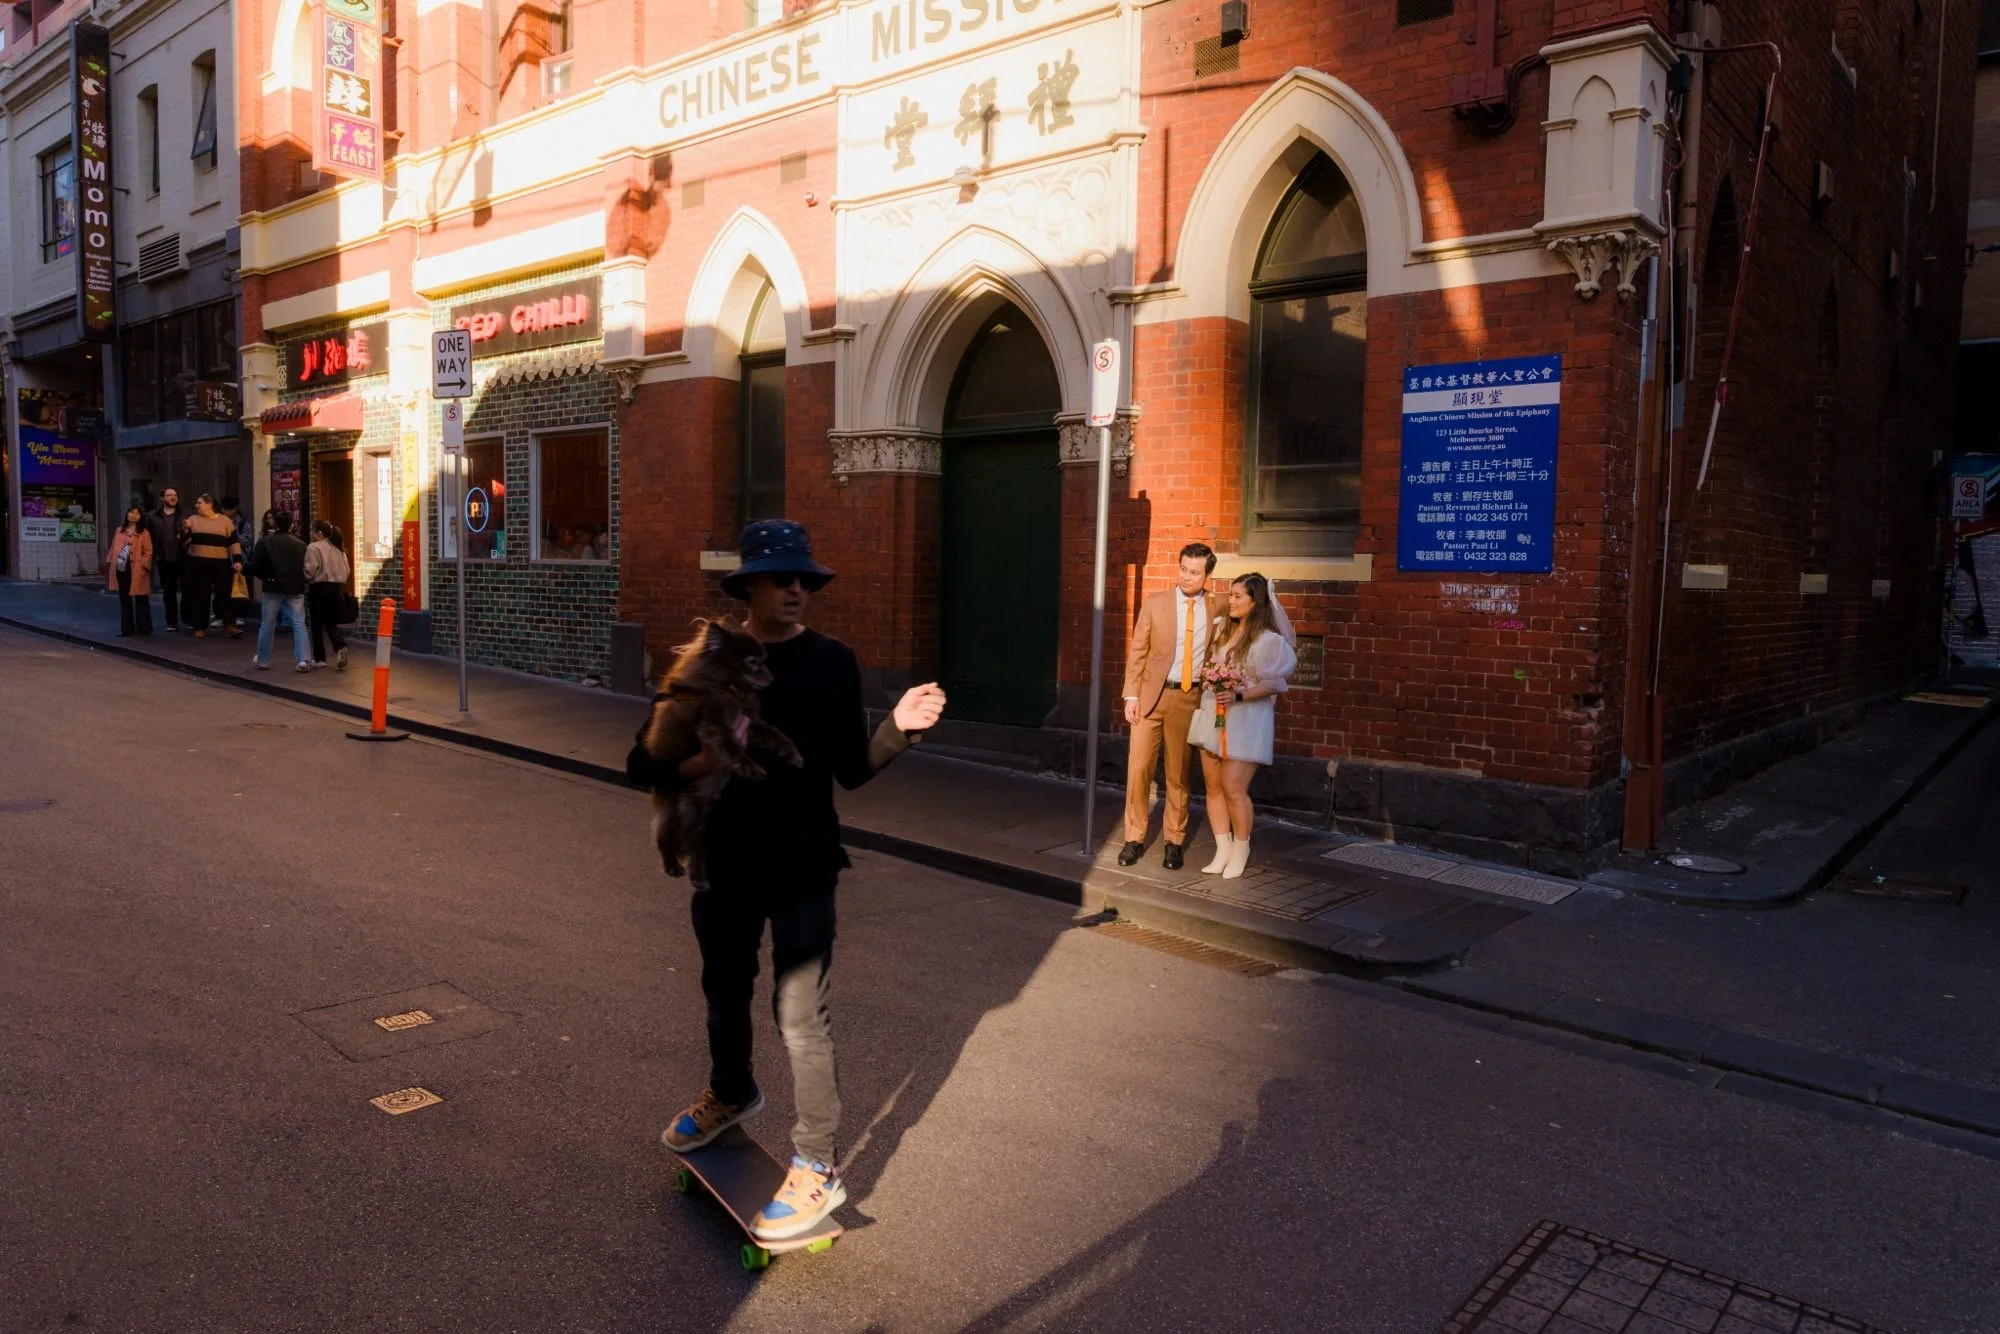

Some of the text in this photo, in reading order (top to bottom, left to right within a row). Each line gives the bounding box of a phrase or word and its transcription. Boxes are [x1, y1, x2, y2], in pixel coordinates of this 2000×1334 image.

[659, 0, 1076, 129] CHINESE MISS
[332, 144, 374, 169] FEAST
[84, 158, 109, 248] Momo
[510, 294, 588, 335] CHILLI
[438, 336, 465, 353] ONE
[437, 357, 467, 374] WAY
[1408, 407, 1551, 423] Anglican Chinese Mission of the Epiphany
[1448, 428, 1467, 436] Little
[1468, 426, 1494, 435] Bourke
[1450, 434, 1505, 444] Melbourne 3000
[1446, 443, 1507, 452] www.acme.org.au
[36, 455, 86, 470] Massage
[1418, 501, 1528, 512] Pastor: Reverend Richard Liu
[1955, 500, 1980, 508] AREA
[1465, 513, 1488, 522] 0422
[1490, 513, 1508, 522] 345
[1511, 512, 1528, 522] 071
[1443, 542, 1499, 551] Pastor: Paul Li
[1464, 552, 1488, 561] 0432
[1489, 552, 1507, 561] 323
[1509, 552, 1528, 561] 828
